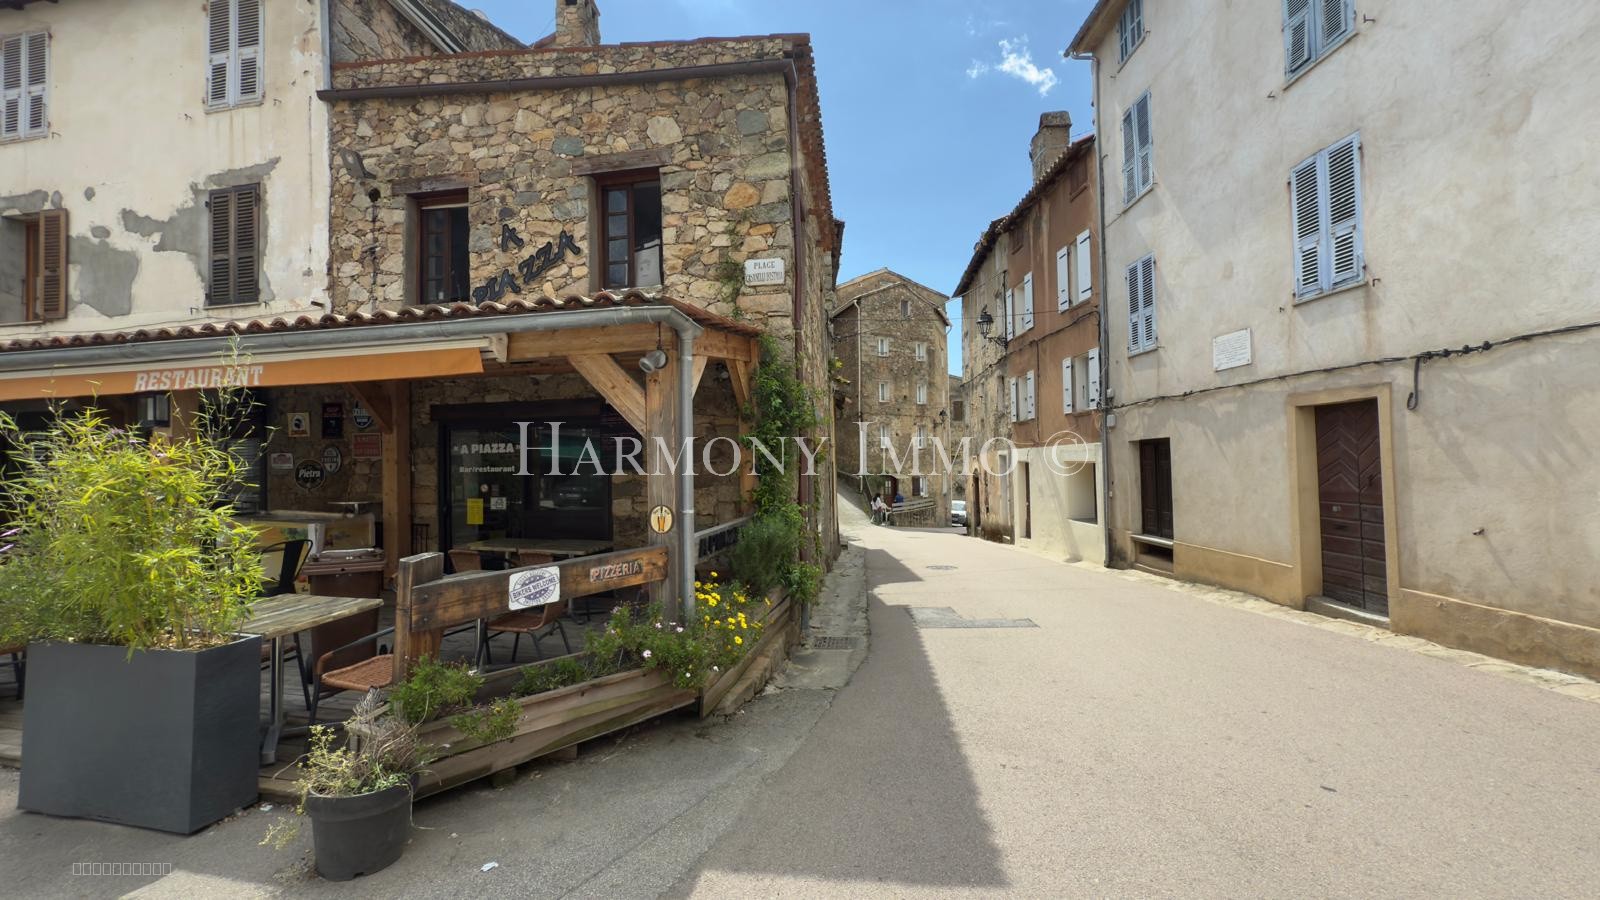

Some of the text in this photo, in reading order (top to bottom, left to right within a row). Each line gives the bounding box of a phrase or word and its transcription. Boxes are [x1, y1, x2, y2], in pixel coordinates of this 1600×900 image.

[753, 261, 776, 269] PLACE
[134, 365, 263, 392] RESTAURANT
[471, 443, 515, 454] PIAZZA
[298, 469, 321, 478] Pietra
[591, 560, 642, 582] PIZZERIA
[512, 586, 532, 599] BIKERS
[532, 576, 556, 592] WELCOME
